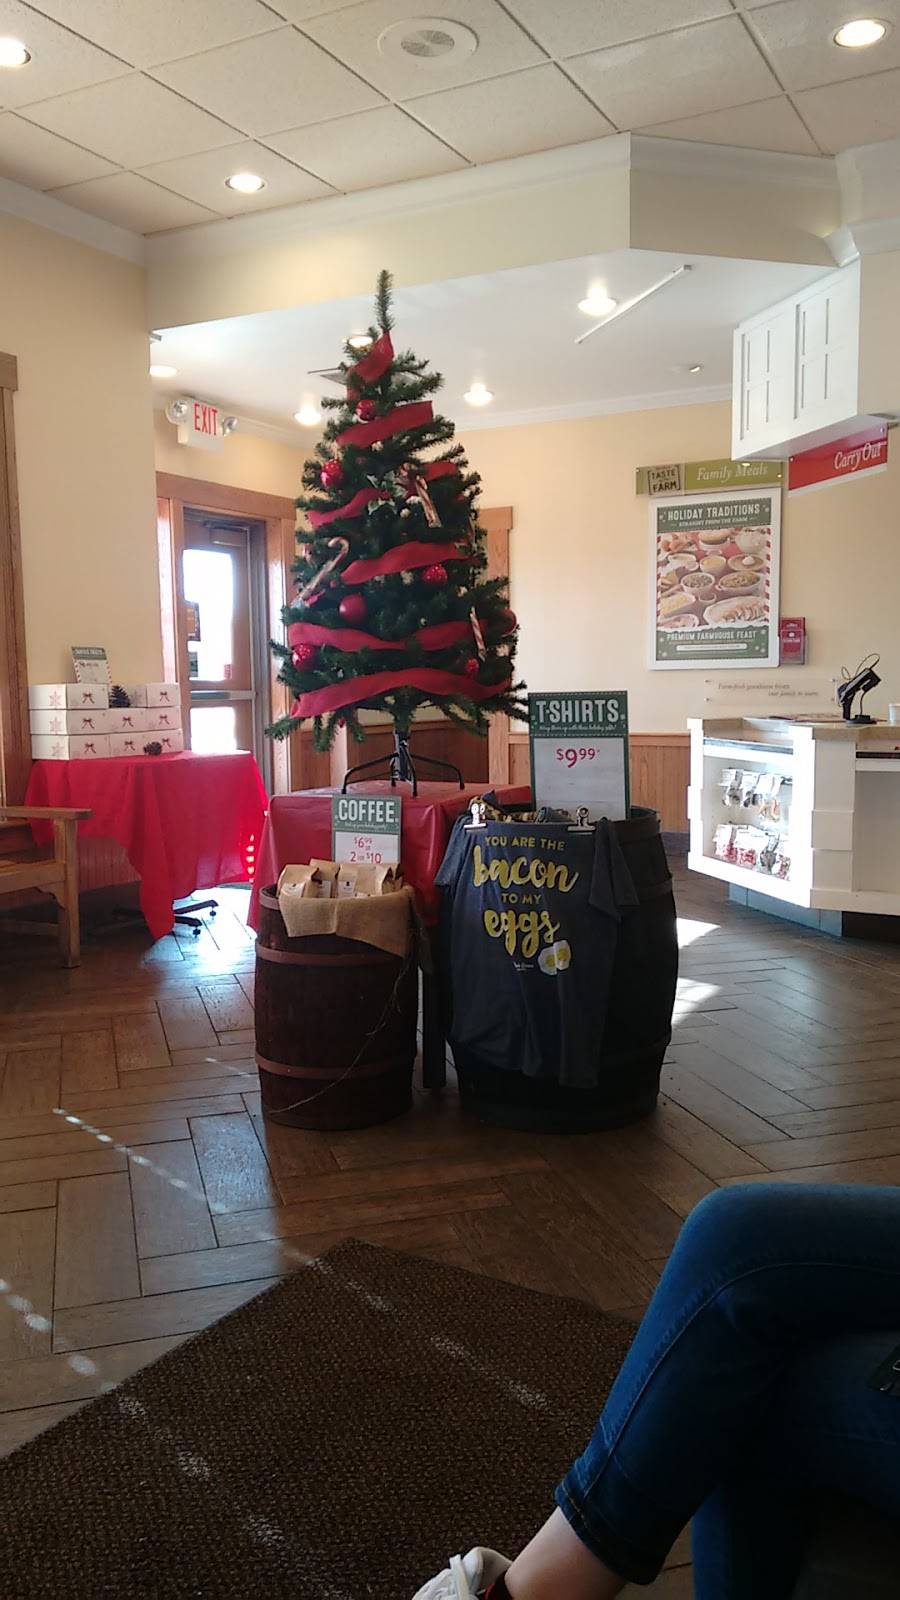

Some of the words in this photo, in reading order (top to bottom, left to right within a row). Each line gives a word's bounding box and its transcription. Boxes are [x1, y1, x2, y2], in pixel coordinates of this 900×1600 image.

[195, 403, 218, 436] EXIT
[834, 450, 861, 470] Carry
[862, 442, 887, 460] Out
[652, 469, 676, 480] TASTE
[697, 465, 732, 483] Family
[735, 462, 768, 477] Meals
[653, 480, 677, 493] FARM
[668, 508, 703, 521] HOLIDAY
[707, 504, 760, 518] TRADITIONS
[667, 631, 695, 641] PREMIUM
[697, 631, 734, 640] FARMHOUSE
[736, 630, 757, 640] FEAST
[536, 699, 619, 723] T-SHIRTS
[338, 799, 395, 823] COFFEE
[485, 836, 507, 846] YOU
[511, 836, 535, 847] ARE
[541, 838, 565, 851] THE
[350, 851, 356, 862] 2
[366, 852, 382, 864] $10
[473, 845, 579, 892] bacon
[501, 893, 518, 903] TO
[522, 894, 542, 904] MY
[484, 909, 560, 958] eggs
